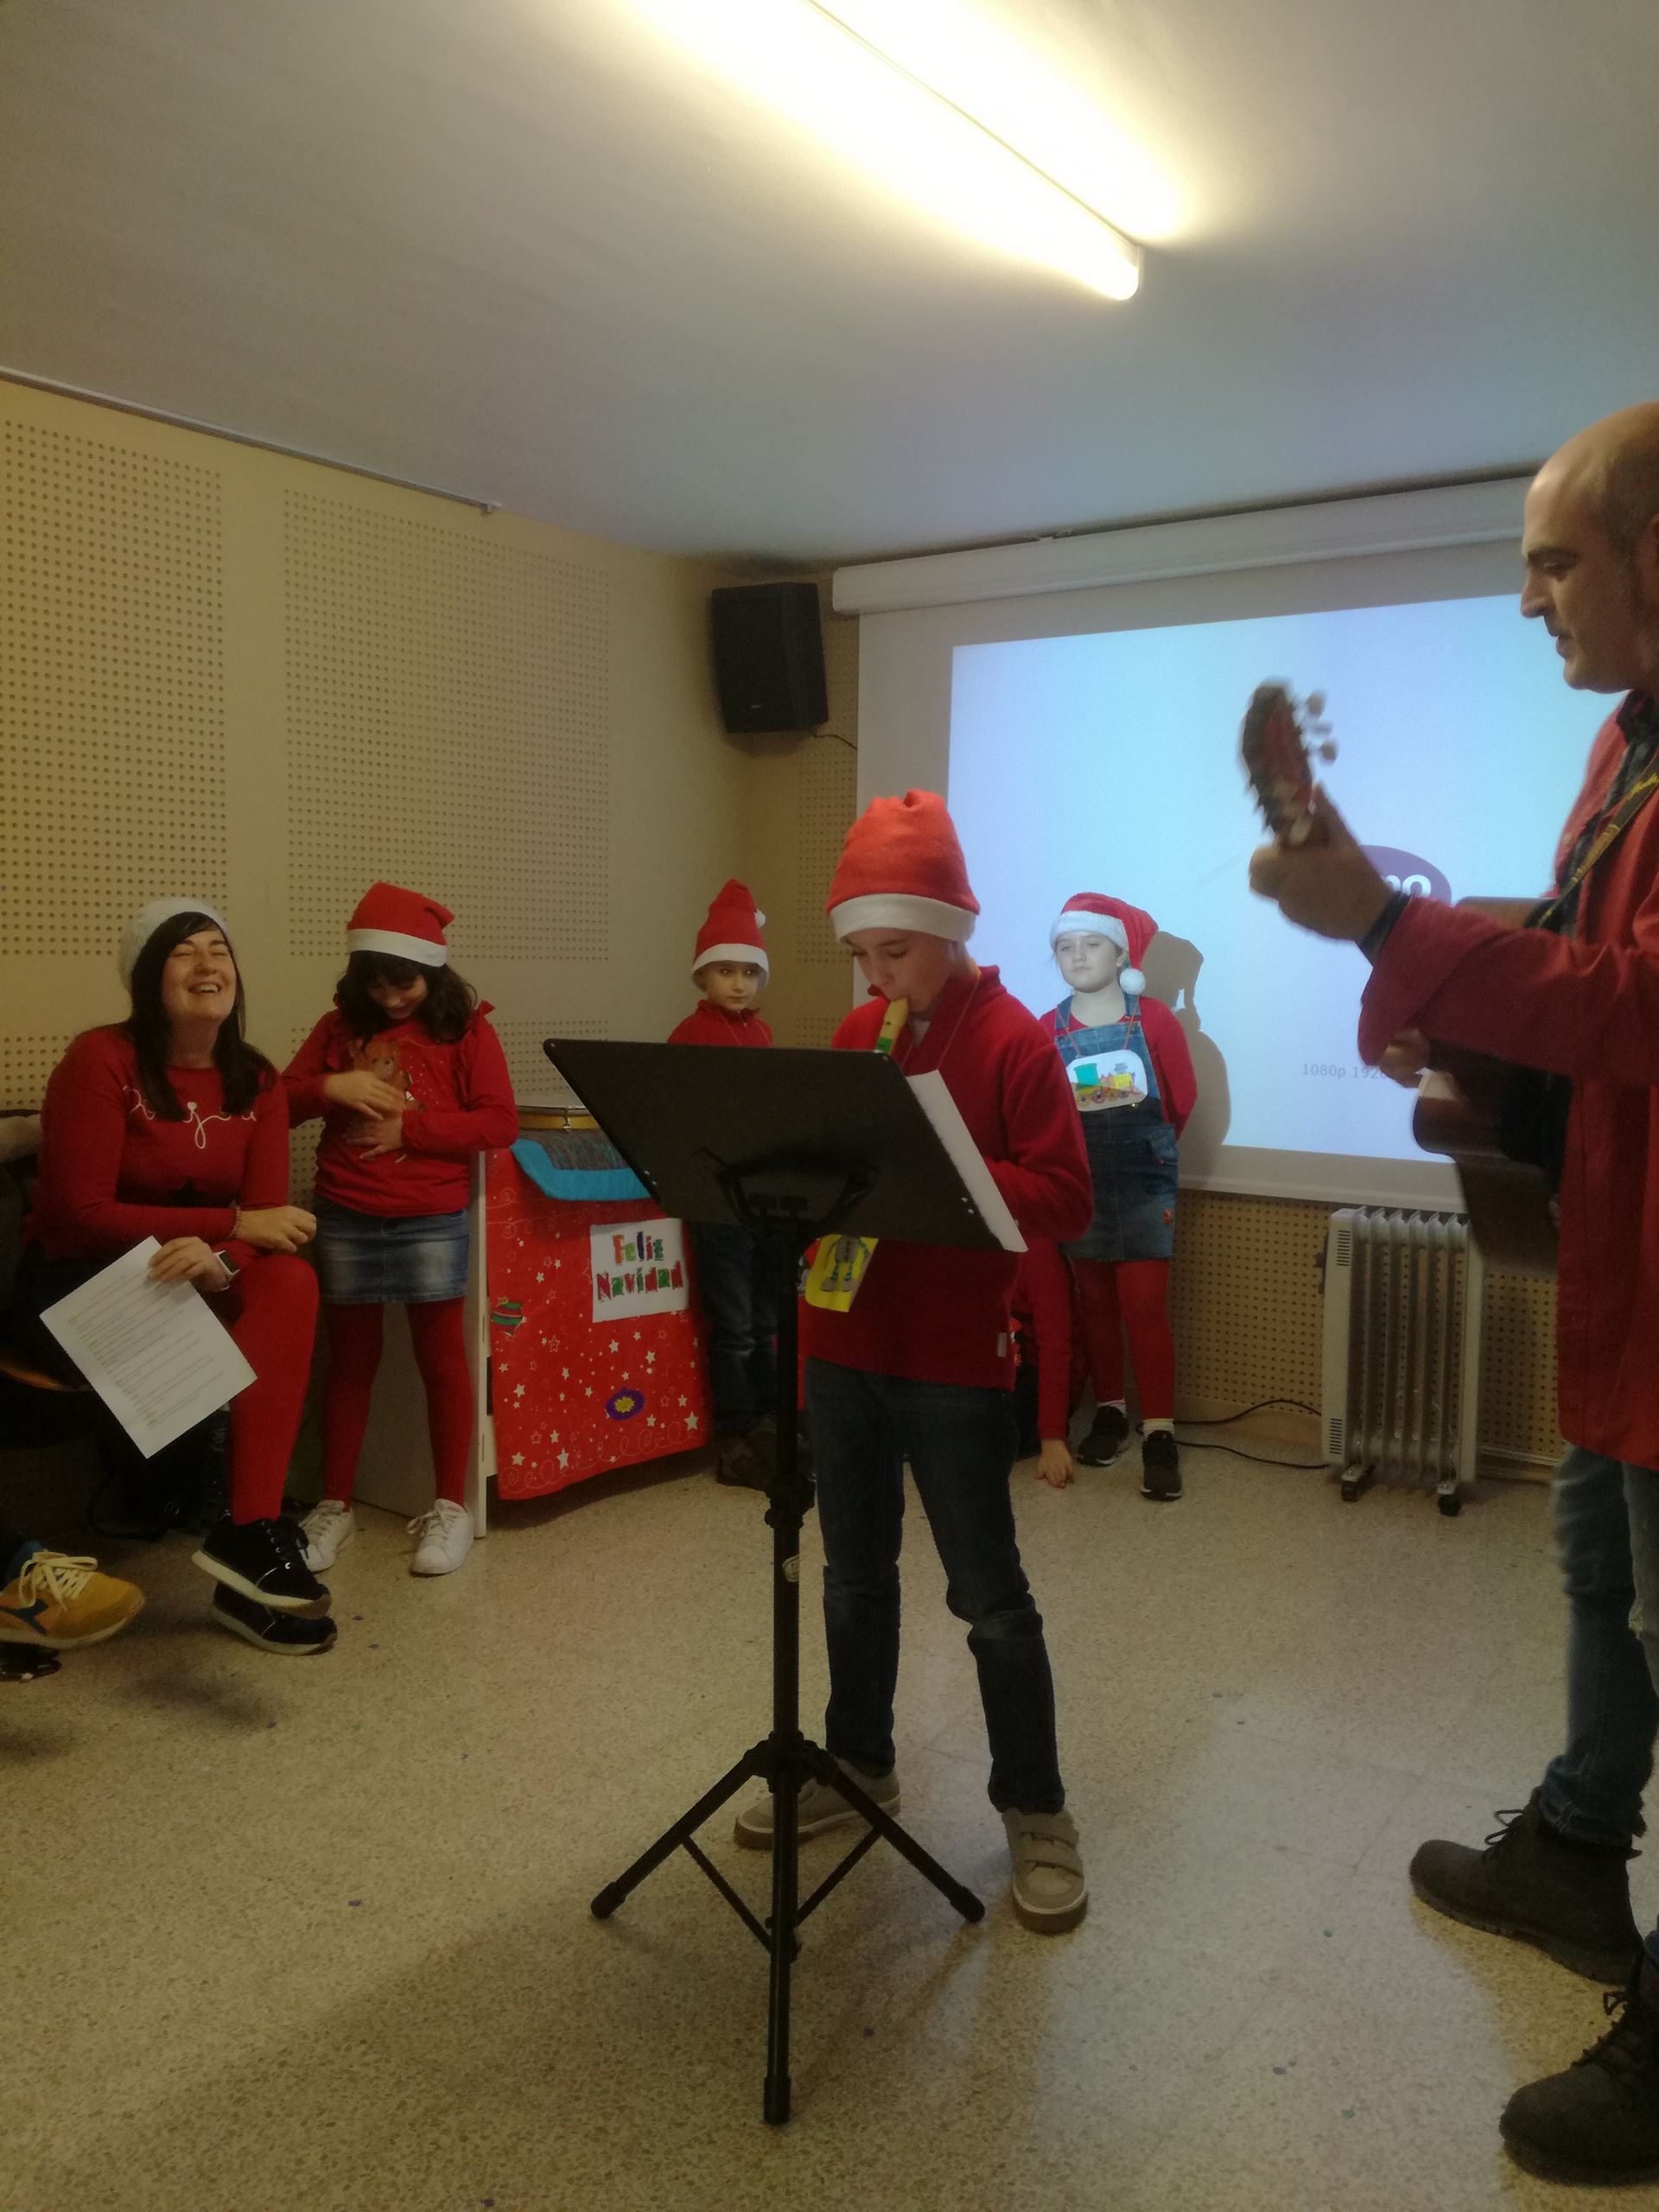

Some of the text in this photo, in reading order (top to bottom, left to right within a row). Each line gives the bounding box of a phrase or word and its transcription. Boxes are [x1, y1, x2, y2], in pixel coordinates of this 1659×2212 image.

[1302, 1064, 1346, 1080] 1080p
[613, 1231, 664, 1265] Feliz
[596, 1260, 683, 1301] Navidad
